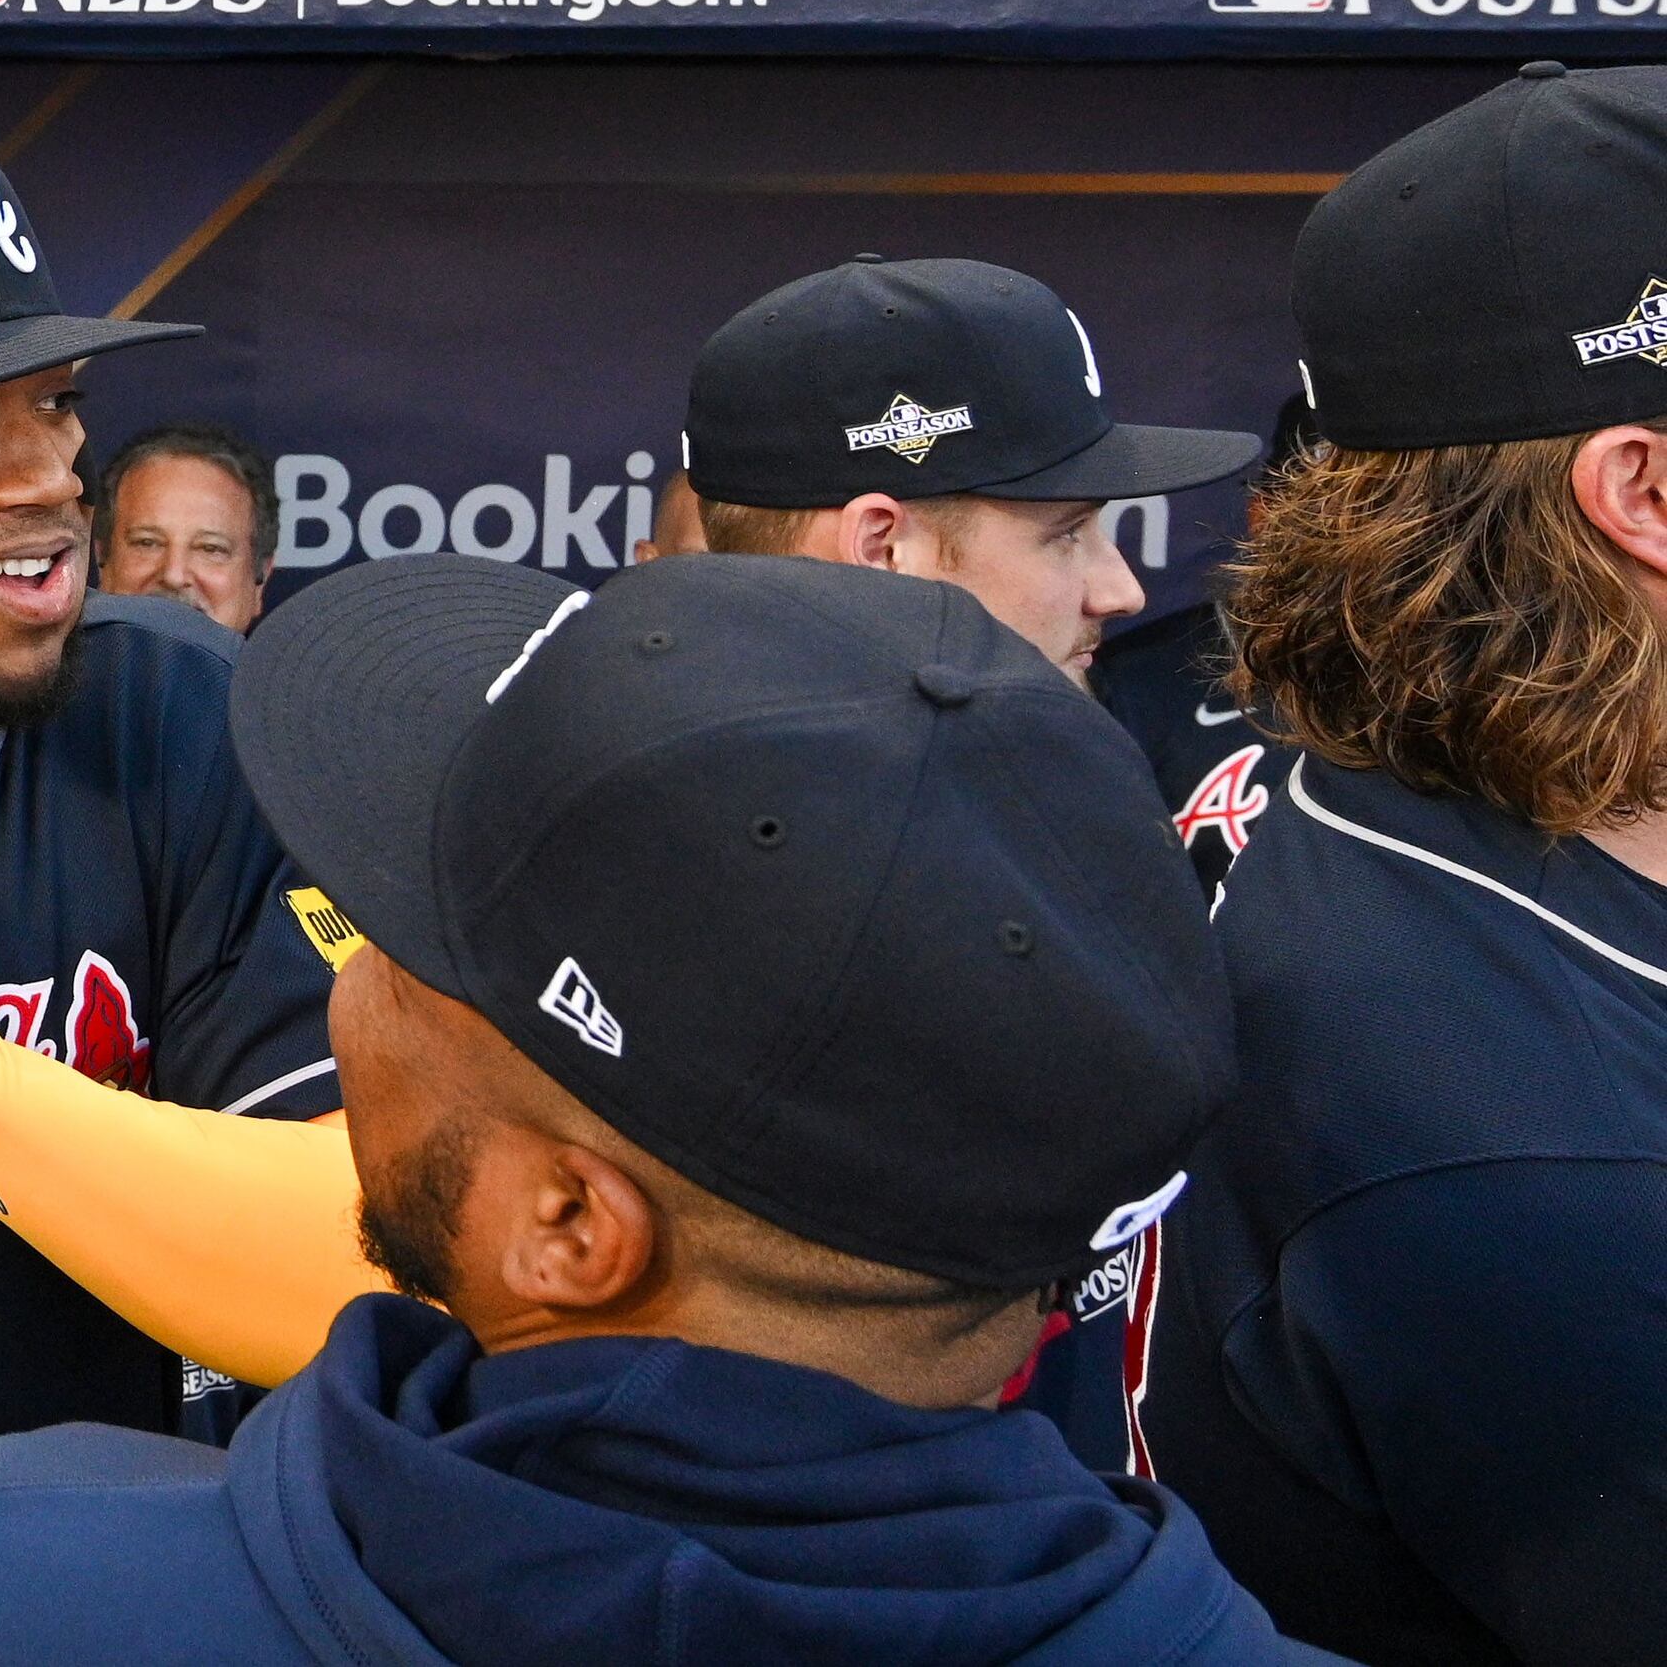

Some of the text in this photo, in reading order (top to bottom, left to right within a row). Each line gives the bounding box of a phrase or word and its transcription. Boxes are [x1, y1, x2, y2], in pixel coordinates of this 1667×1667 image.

[1575, 320, 1667, 361] POSTS
[847, 410, 972, 449] POSTSEASON
[275, 451, 655, 571] Booki
